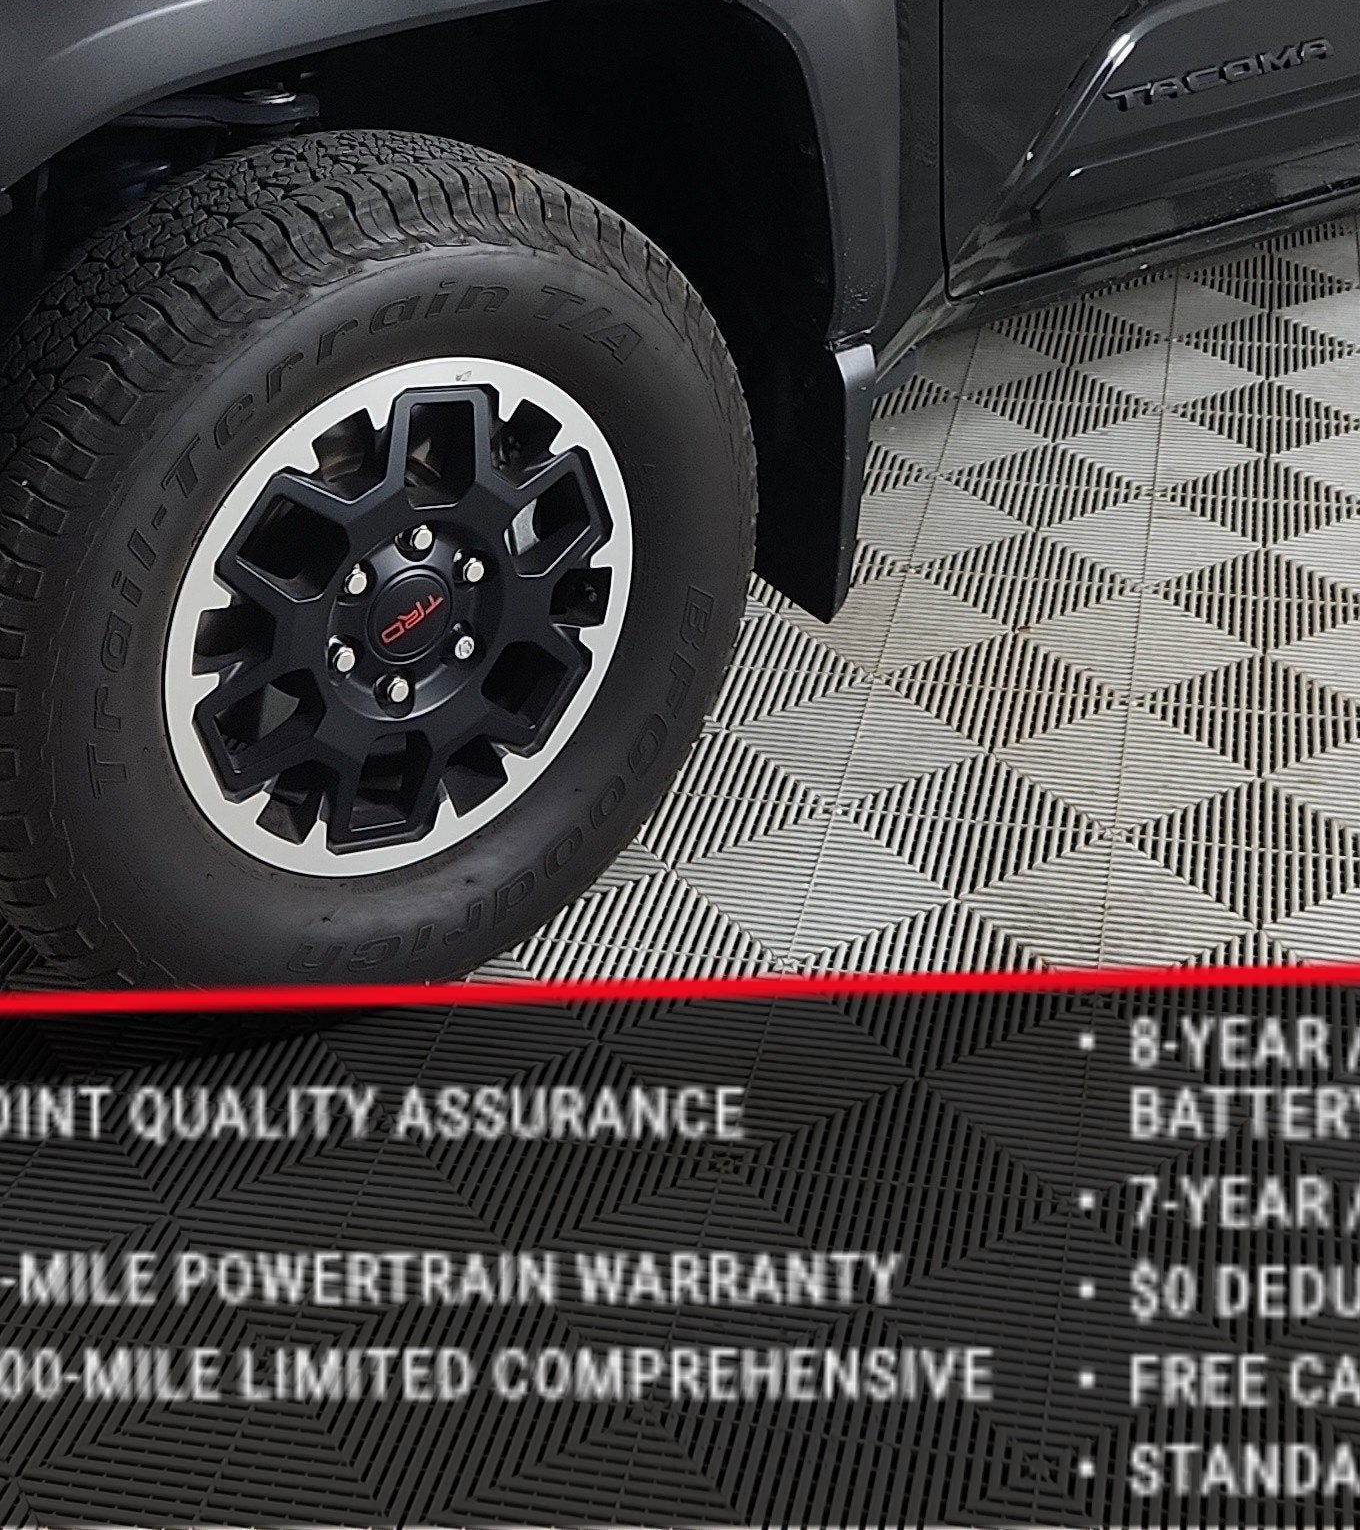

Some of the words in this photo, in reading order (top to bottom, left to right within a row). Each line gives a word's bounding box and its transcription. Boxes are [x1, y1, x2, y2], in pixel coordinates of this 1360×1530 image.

[1102, 37, 1334, 111] TACOMA
[87, 278, 512, 798] Trail-Terrain
[532, 284, 646, 365] T/A
[381, 592, 445, 645] TRD
